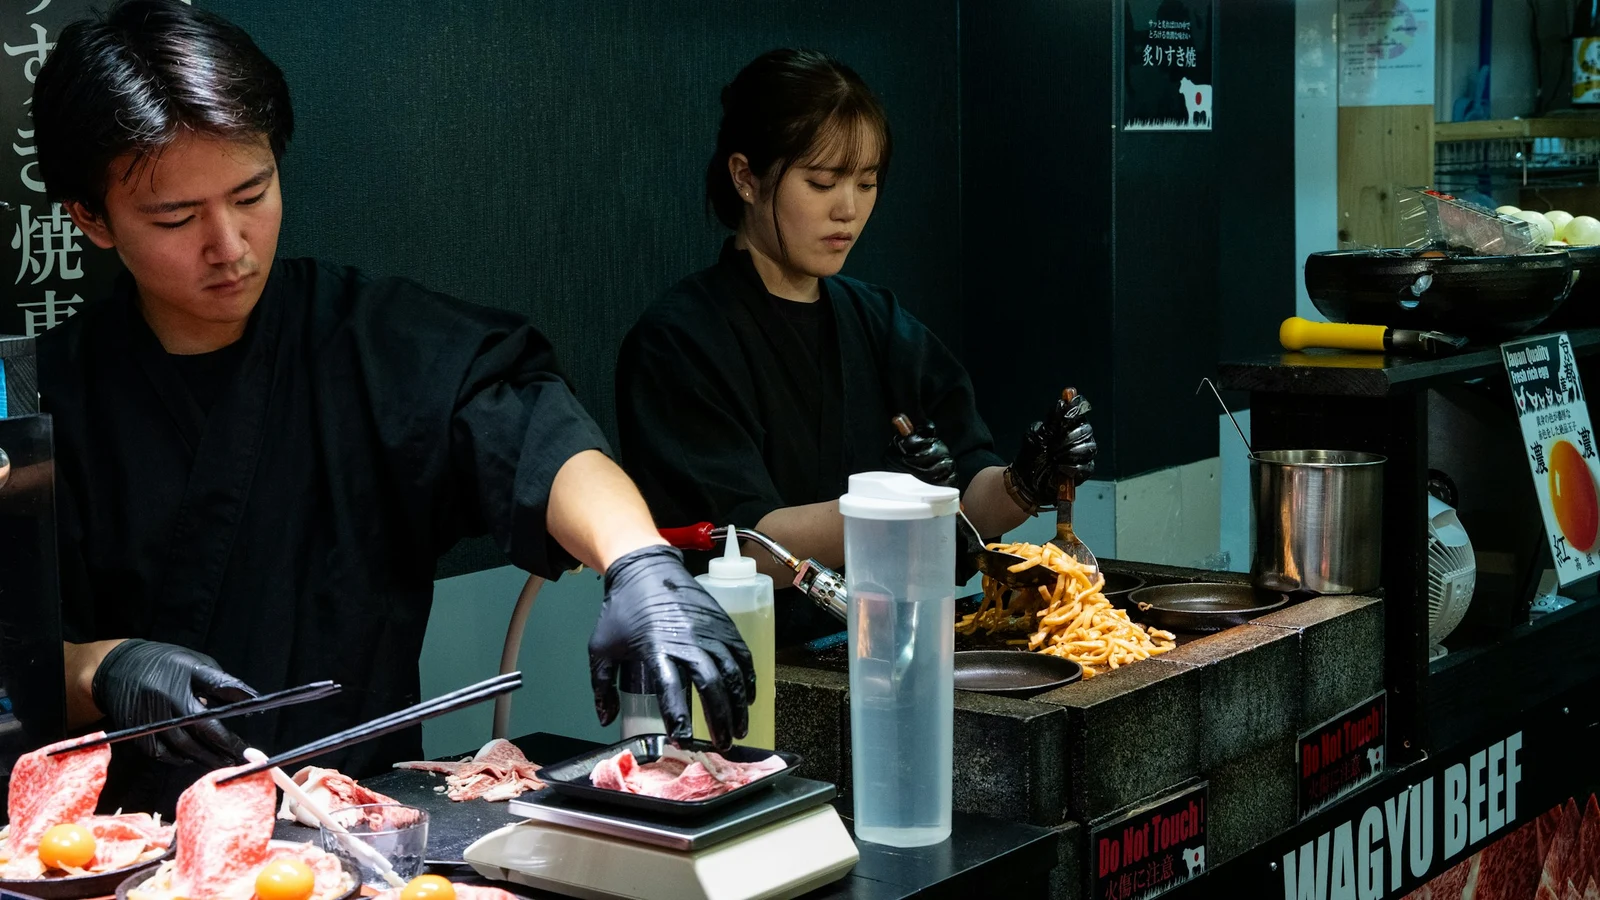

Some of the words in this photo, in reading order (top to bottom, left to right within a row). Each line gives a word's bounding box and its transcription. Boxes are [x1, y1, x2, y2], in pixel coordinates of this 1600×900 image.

[1142, 44, 1197, 67] 炙りすき焼
[1506, 350, 1528, 368] Japan
[1525, 345, 1550, 364] Quality
[1511, 369, 1528, 384] Fresh
[1526, 366, 1539, 381] rich
[1537, 366, 1550, 379] egg
[1303, 743, 1320, 780] Do
[1321, 728, 1343, 769] Not
[1309, 753, 1362, 800] 火傷に注意
[1283, 776, 1434, 900] WAGYU
[1444, 730, 1523, 861] BEEF
[1099, 837, 1120, 879] Do
[1123, 821, 1150, 868] Not
[1105, 854, 1175, 900] 火傷に注意
